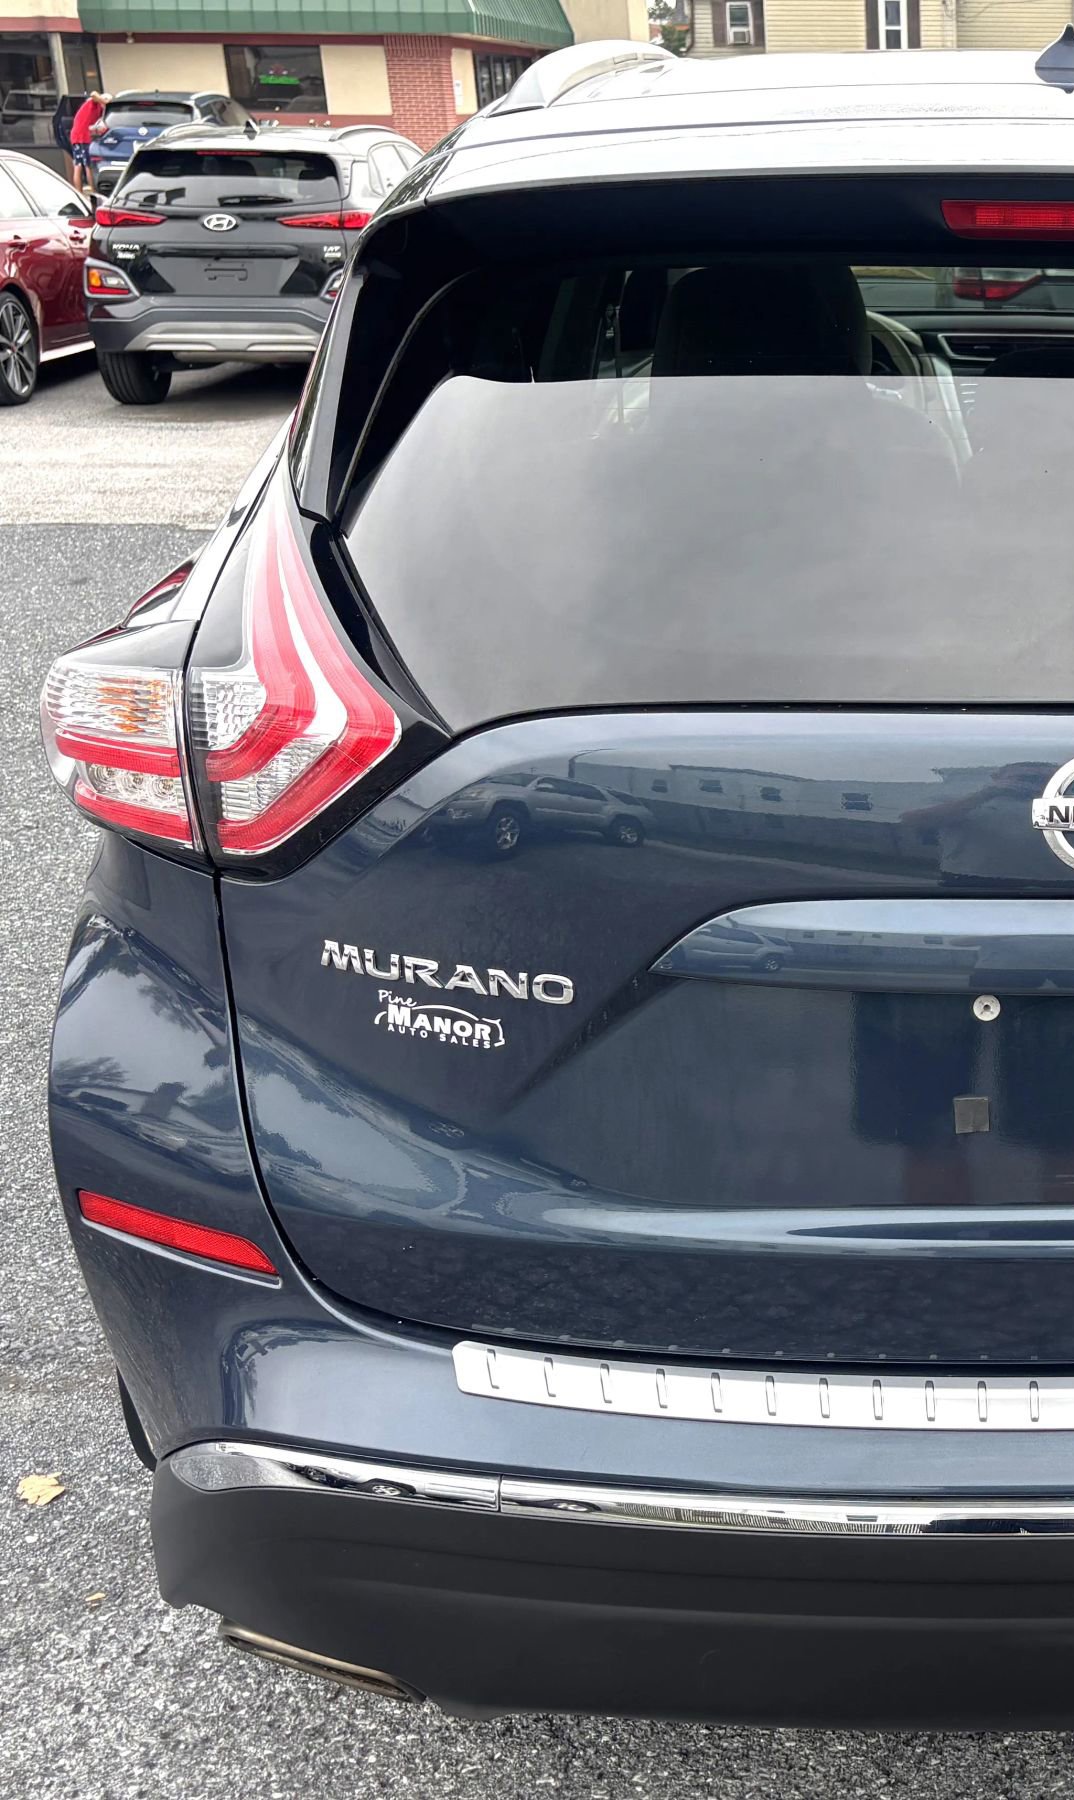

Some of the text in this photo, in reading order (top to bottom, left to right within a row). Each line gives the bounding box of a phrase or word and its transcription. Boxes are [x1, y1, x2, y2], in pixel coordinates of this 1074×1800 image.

[320, 939, 574, 1005] MURANO
[377, 989, 417, 1008] Pine
[387, 1003, 492, 1041] MANOR
[388, 1023, 491, 1049] AUTO SALES
